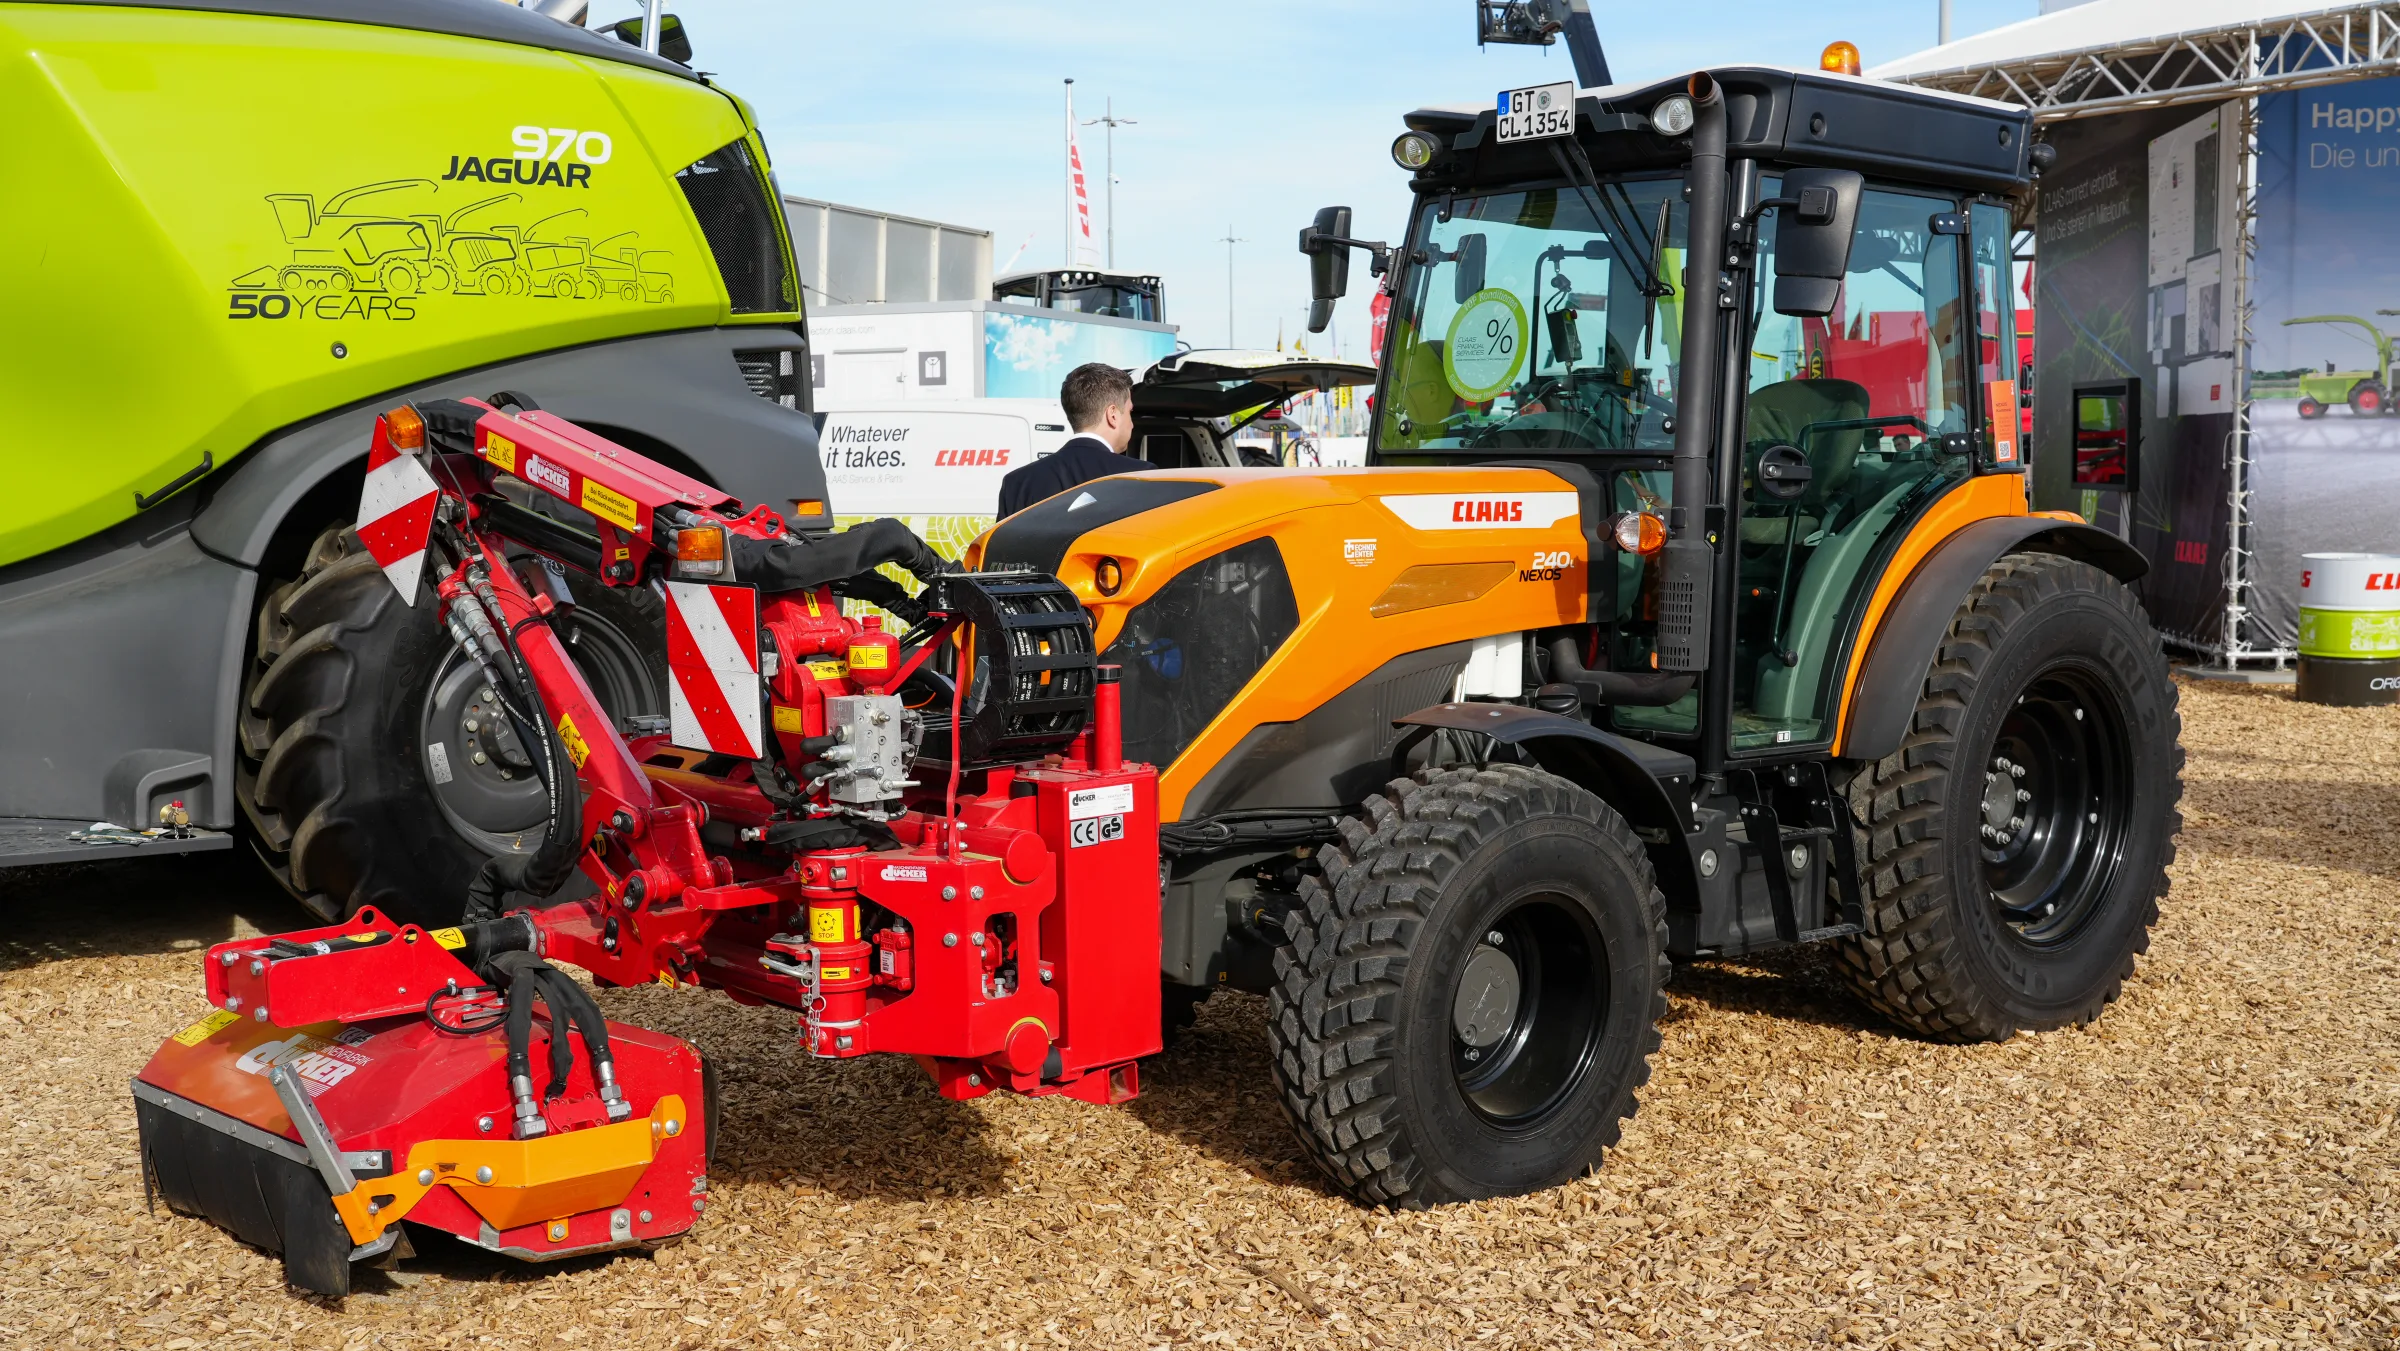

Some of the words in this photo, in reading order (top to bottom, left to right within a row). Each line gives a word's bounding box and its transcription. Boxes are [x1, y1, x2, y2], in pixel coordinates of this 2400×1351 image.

[1512, 90, 1535, 114] GT
[2311, 102, 2400, 134] Happ
[511, 125, 613, 165] 970
[2310, 142, 2356, 169] Die
[442, 155, 592, 189] JAGUAR
[1070, 132, 1090, 238] CLAA
[2044, 186, 2065, 213] CLAAS
[1487, 317, 1513, 356] %
[1455, 349, 1485, 357] SERVICES
[831, 425, 910, 444] Whatever
[825, 447, 839, 469] it
[845, 445, 907, 469] takes.
[935, 449, 1011, 467] CLAAS
[590, 486, 598, 494] Bei
[849, 474, 876, 485] Service
[884, 474, 904, 484] Parts
[583, 494, 617, 516] Arbeitswerkzeug
[615, 511, 635, 523] anheben
[1452, 501, 1523, 522] CLAAS
[2174, 540, 2209, 565] CLAAS
[1519, 567, 1563, 583] NEXOS
[1073, 821, 1095, 844] CE
